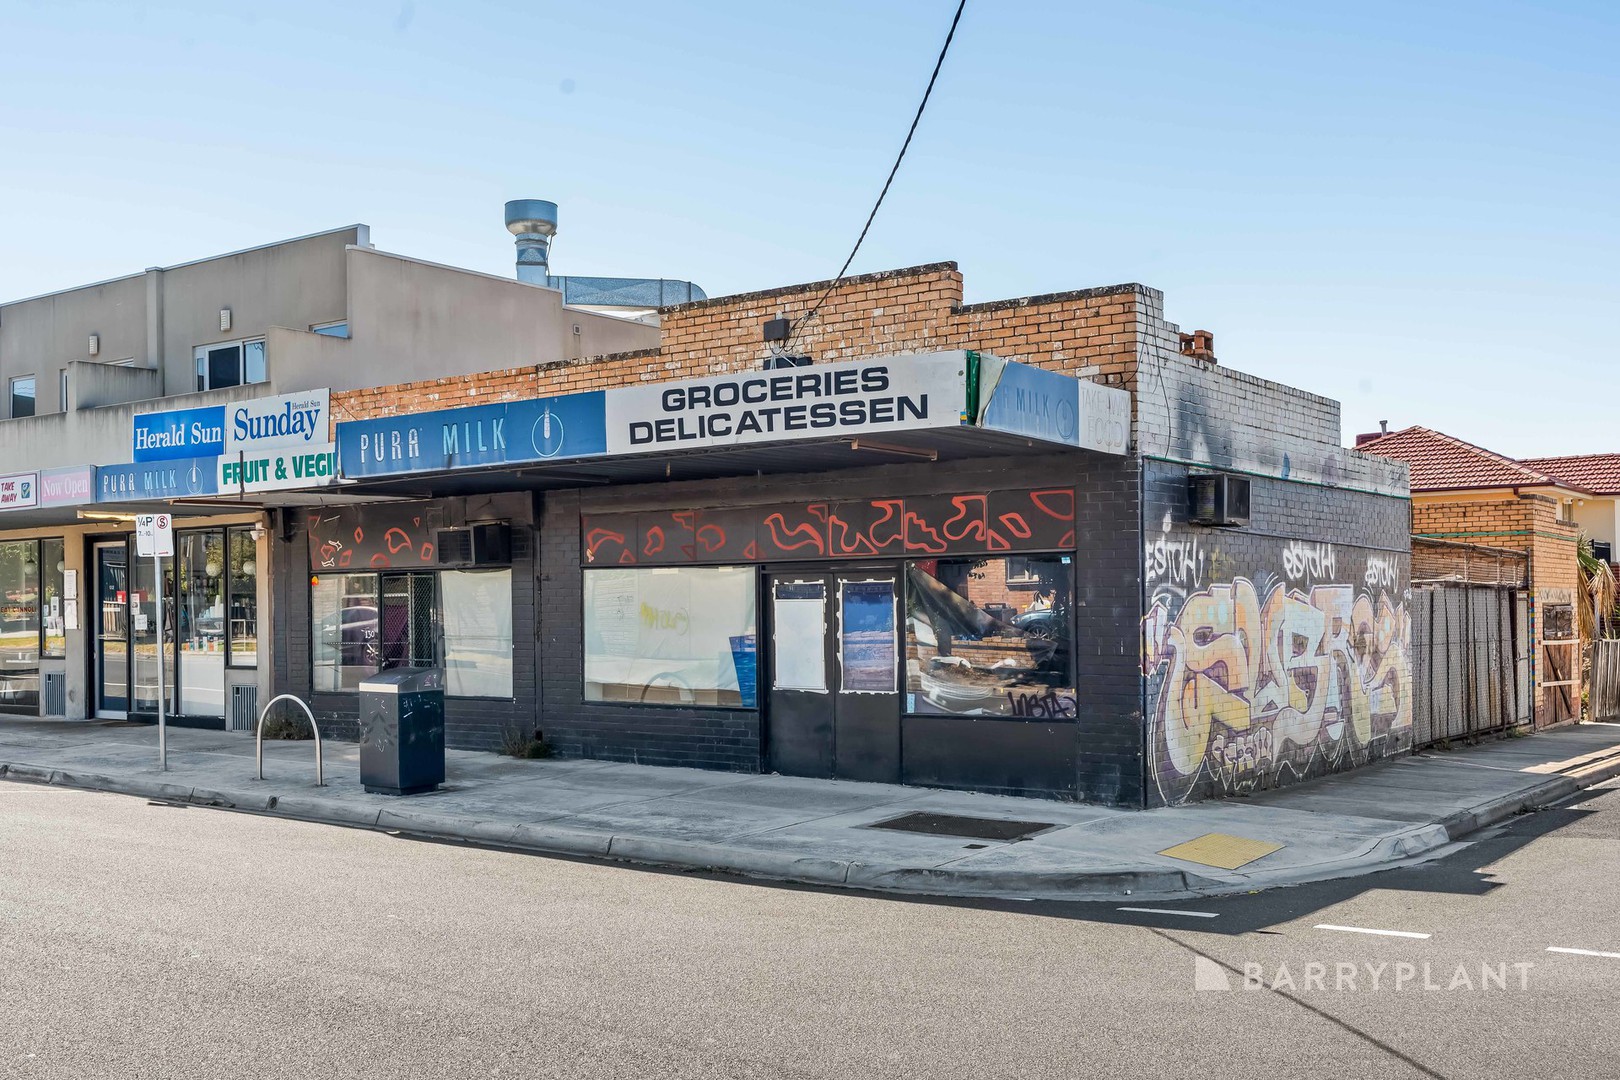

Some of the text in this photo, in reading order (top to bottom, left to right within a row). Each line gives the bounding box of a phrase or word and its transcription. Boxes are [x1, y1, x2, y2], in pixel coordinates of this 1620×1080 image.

[662, 366, 889, 412] GROCERIES
[1016, 387, 1050, 418] MILK
[233, 402, 321, 441] Sunday
[629, 393, 929, 445] DELICATESSEN
[135, 422, 222, 450] Herald Sun
[360, 417, 506, 464] PURA MILK
[103, 469, 177, 493] PURA MILK
[223, 453, 336, 485] FRUIT & VEGI
[1, 482, 15, 492] TAKE
[1, 493, 17, 503] AWAY
[43, 476, 88, 497] Now Open
